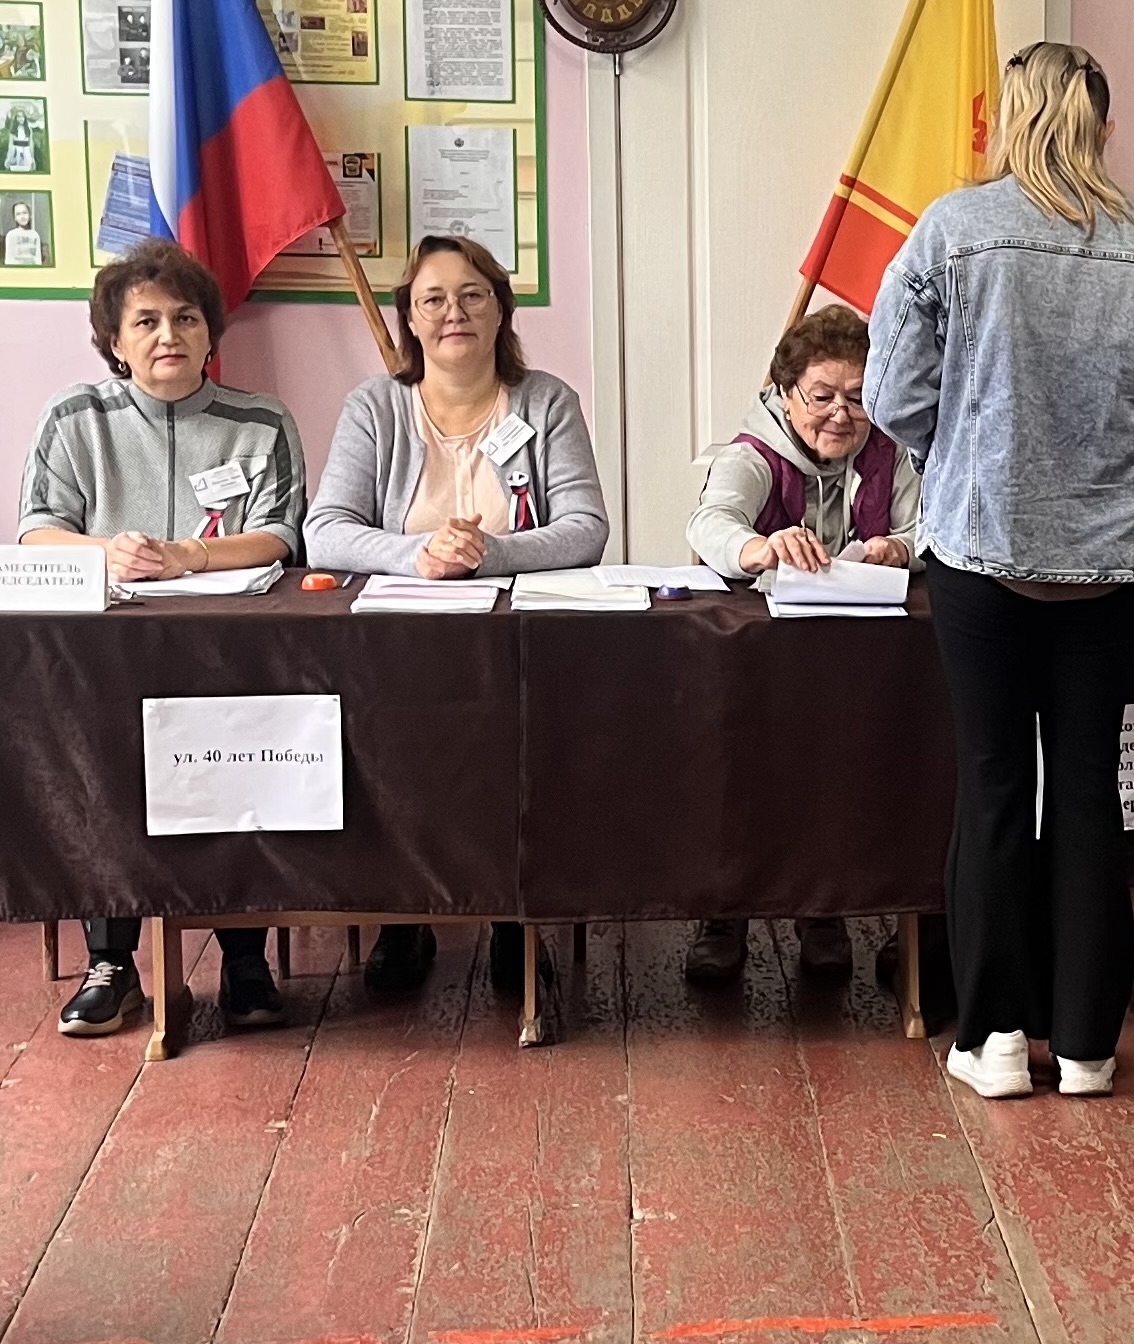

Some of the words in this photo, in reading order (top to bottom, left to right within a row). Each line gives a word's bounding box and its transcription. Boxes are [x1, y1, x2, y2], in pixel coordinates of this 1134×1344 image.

[173, 752, 198, 767] ул.
[202, 749, 222, 763] 40
[226, 752, 256, 763] лет
[261, 748, 324, 764] Победы
